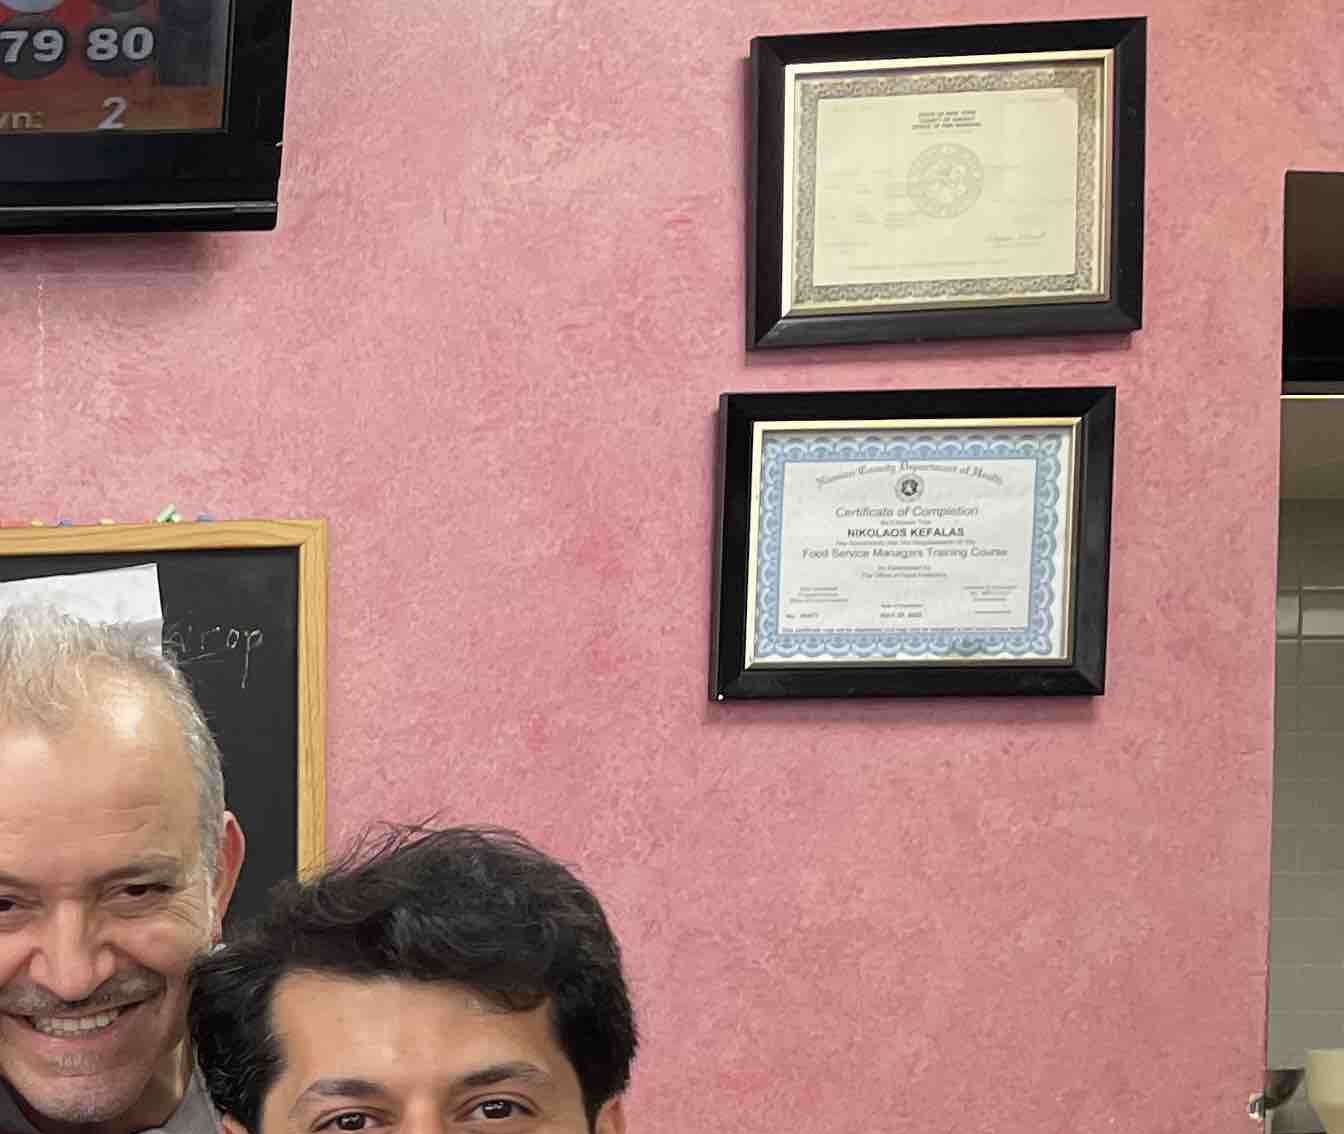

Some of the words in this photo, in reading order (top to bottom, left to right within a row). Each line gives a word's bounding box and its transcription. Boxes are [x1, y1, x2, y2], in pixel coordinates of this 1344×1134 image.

[0, 29, 65, 64] 79
[86, 26, 154, 61] 80
[96, 97, 128, 129] 2
[847, 528, 907, 538] NIKOLAOS
[910, 527, 965, 537] KEFALAS
